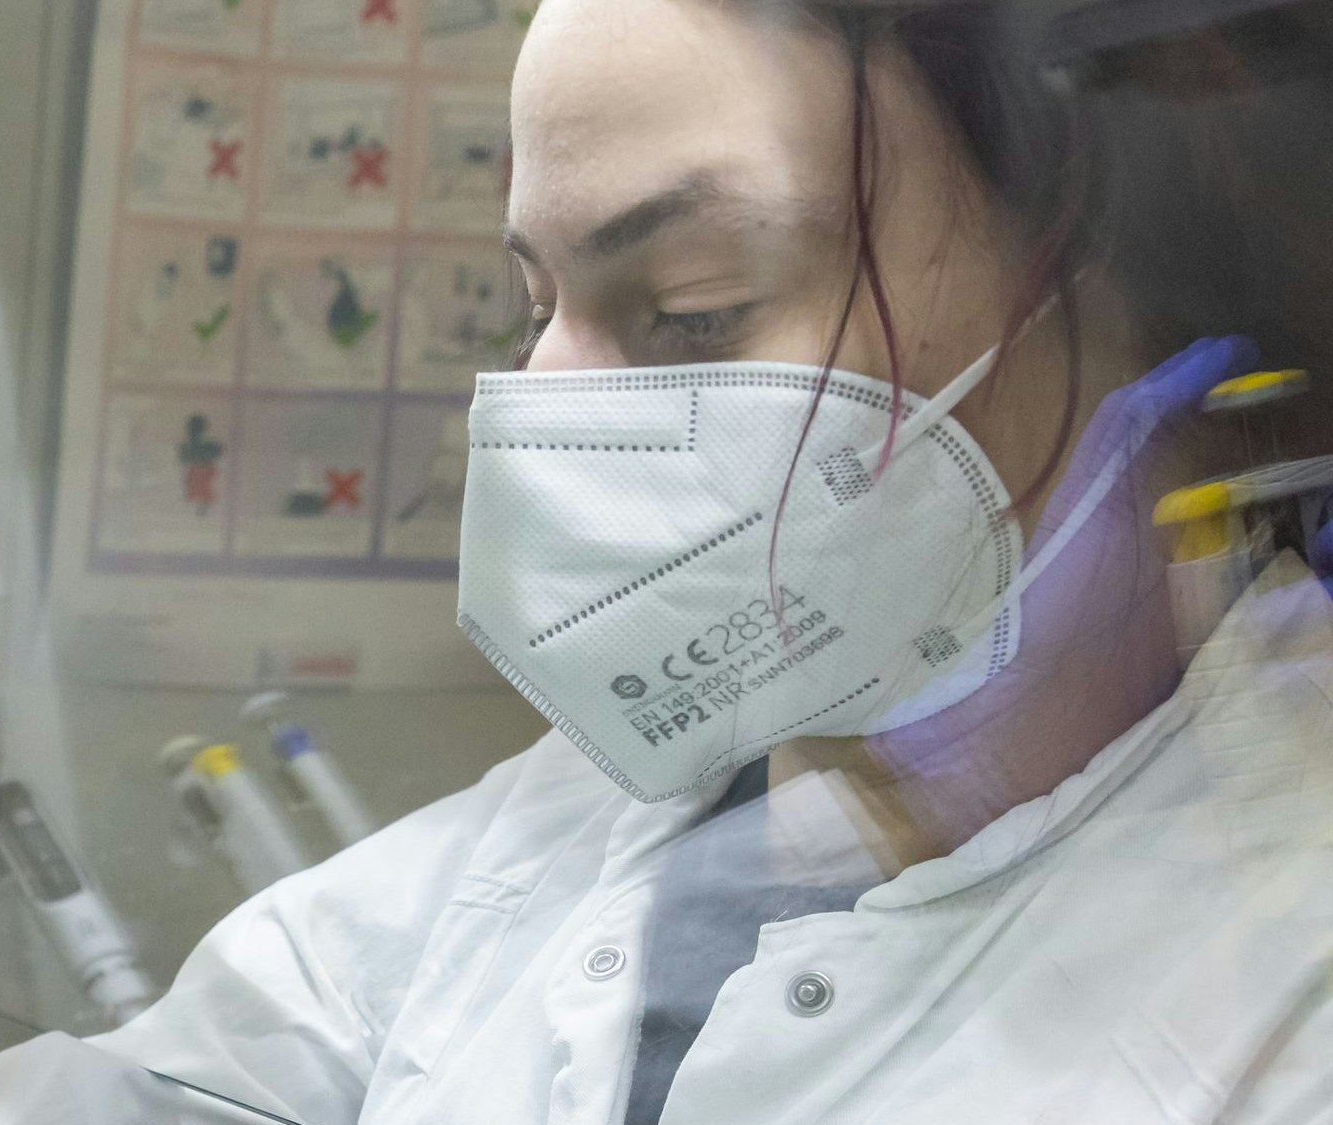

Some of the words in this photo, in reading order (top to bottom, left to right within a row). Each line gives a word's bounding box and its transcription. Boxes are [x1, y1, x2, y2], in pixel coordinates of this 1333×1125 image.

[629, 709, 662, 731] EN
[642, 704, 711, 747] FFP2
[709, 682, 751, 711] NR
